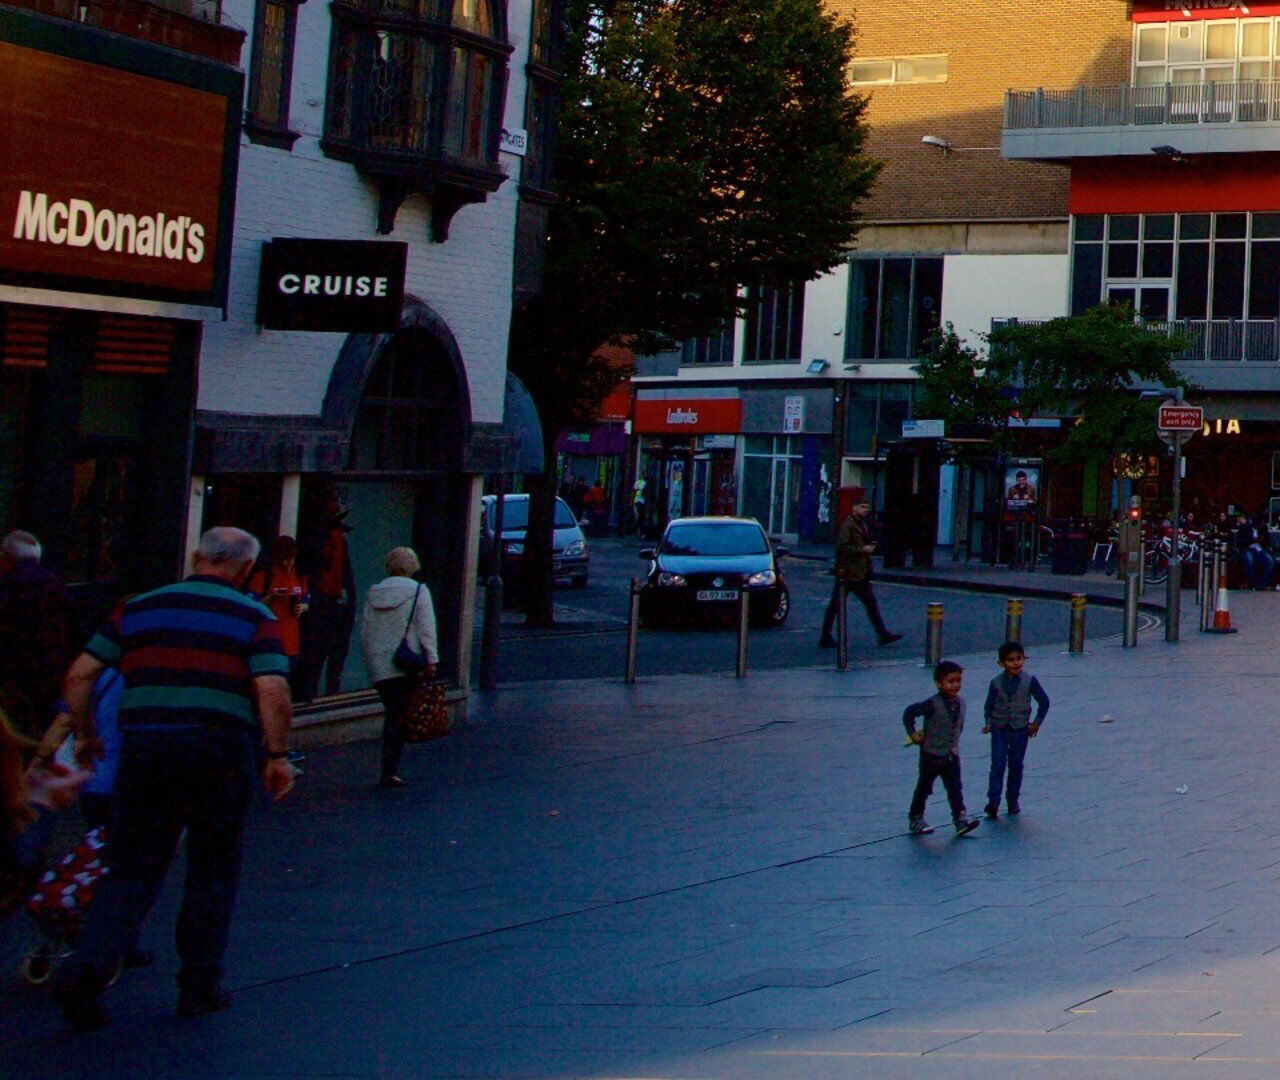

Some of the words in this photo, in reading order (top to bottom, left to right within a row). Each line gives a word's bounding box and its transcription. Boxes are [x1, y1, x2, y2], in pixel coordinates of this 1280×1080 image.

[13, 190, 205, 263] McDonald's
[279, 273, 389, 297] CRUISE
[1162, 410, 1201, 419] Emergency
